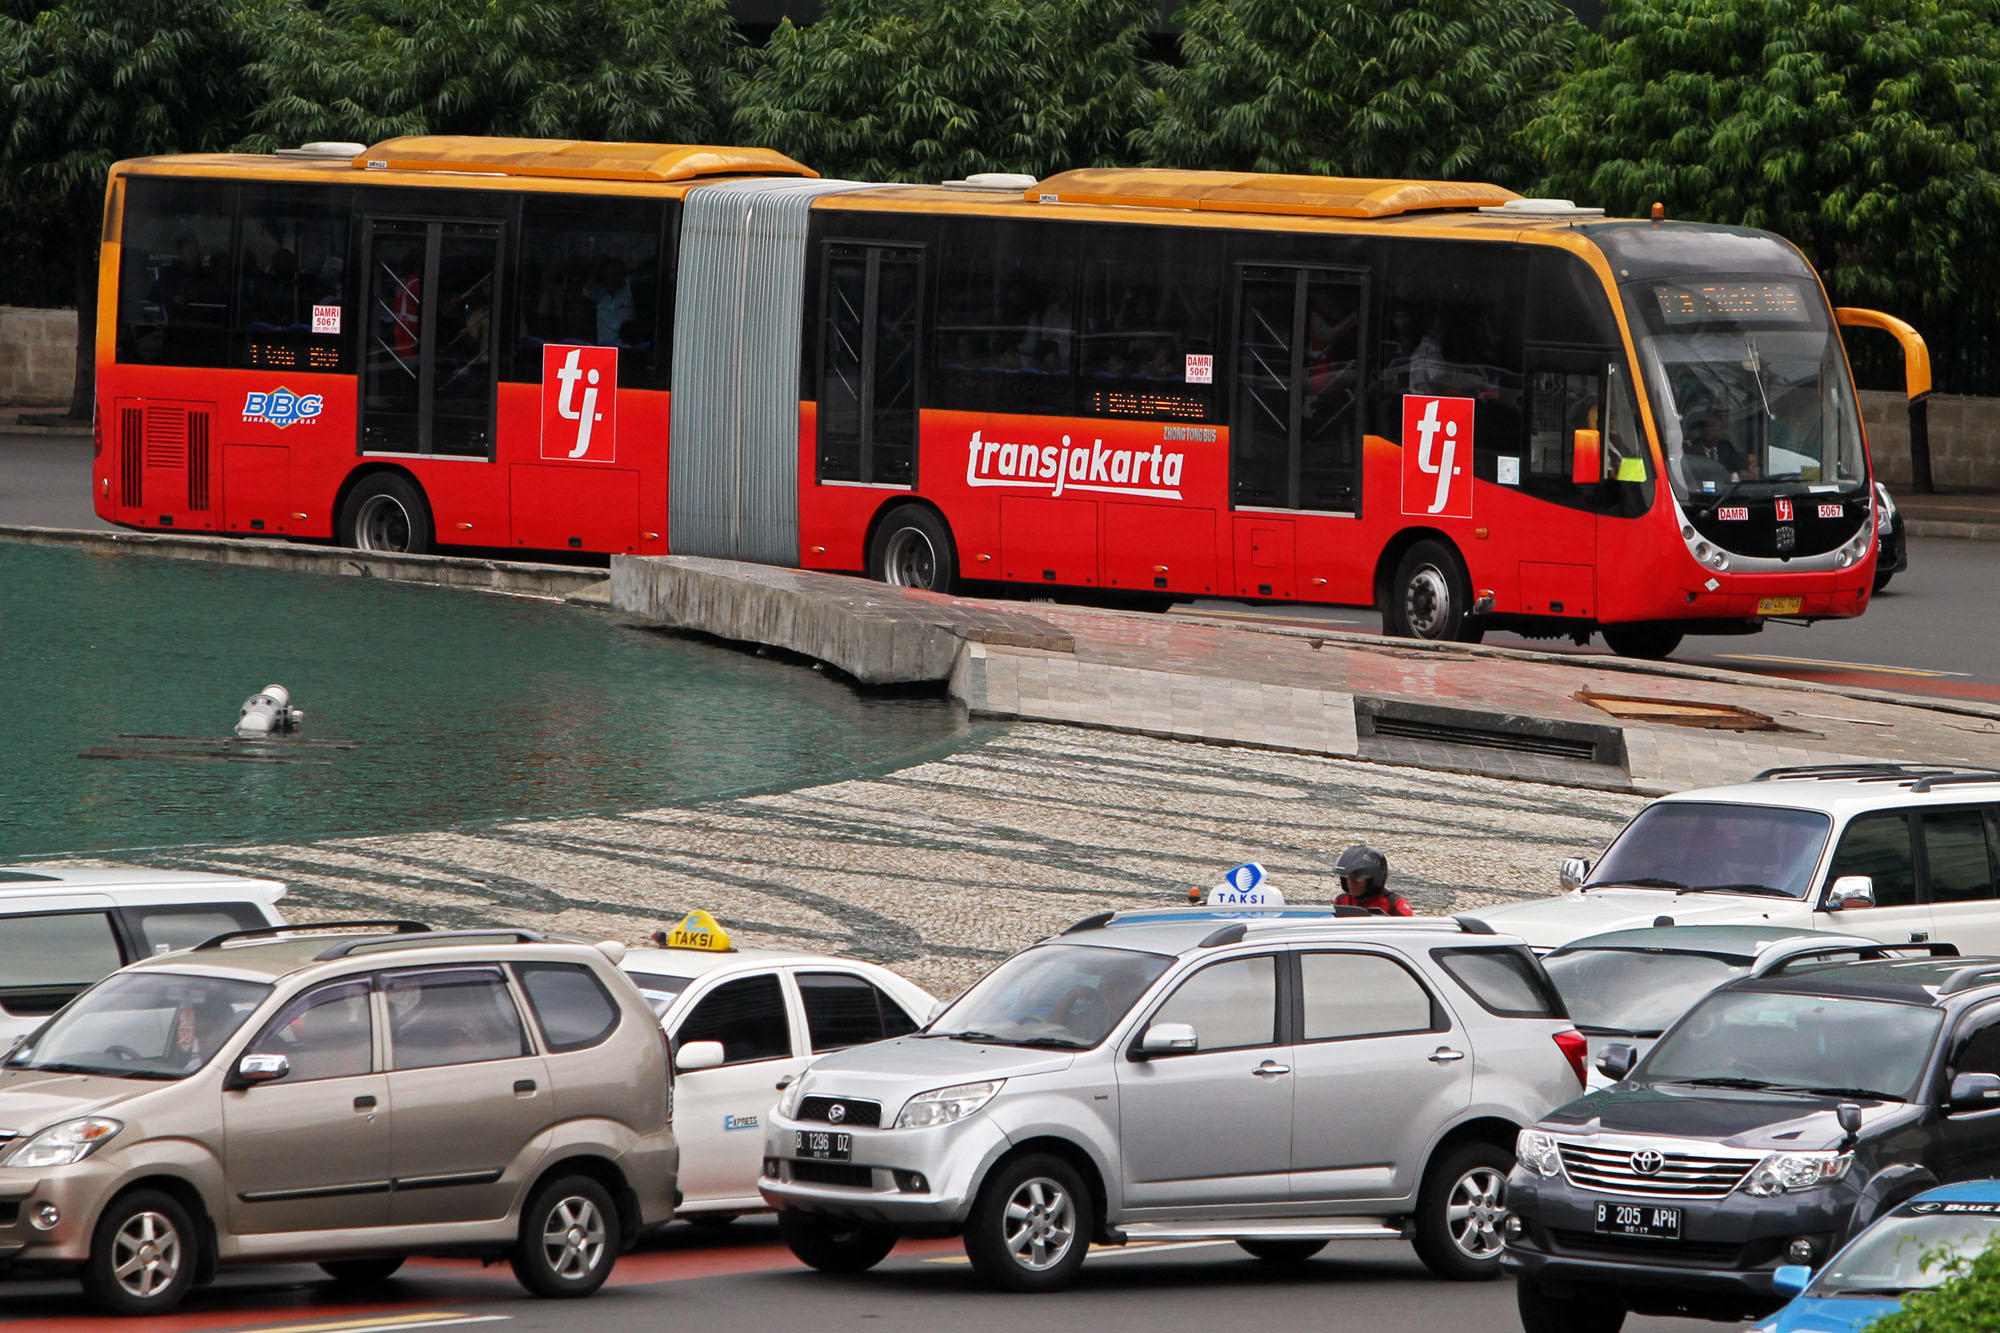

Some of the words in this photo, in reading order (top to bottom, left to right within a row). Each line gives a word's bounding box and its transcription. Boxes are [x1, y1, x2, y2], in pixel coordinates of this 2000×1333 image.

[314, 307, 339, 318] DAMRI
[316, 317, 336, 327] 5067
[1187, 356, 1211, 368] DAMRI
[1189, 367, 1208, 376] 5067
[242, 392, 324, 418] BBG
[1163, 426, 1186, 441] ZHONG
[1186, 427, 1203, 441] TONG
[1203, 429, 1217, 442] BUS
[966, 430, 1184, 500] transjakarta
[1720, 508, 1747, 519] DAMRI
[1820, 505, 1842, 517] 5067
[1217, 893, 1265, 905] TAKSI
[674, 931, 713, 947] TAKSI
[809, 1133, 829, 1150] 1296
[837, 1134, 849, 1152] DZ
[1598, 1204, 1606, 1222] B
[1616, 1206, 1641, 1225] 205
[1652, 1208, 1677, 1228] APH
